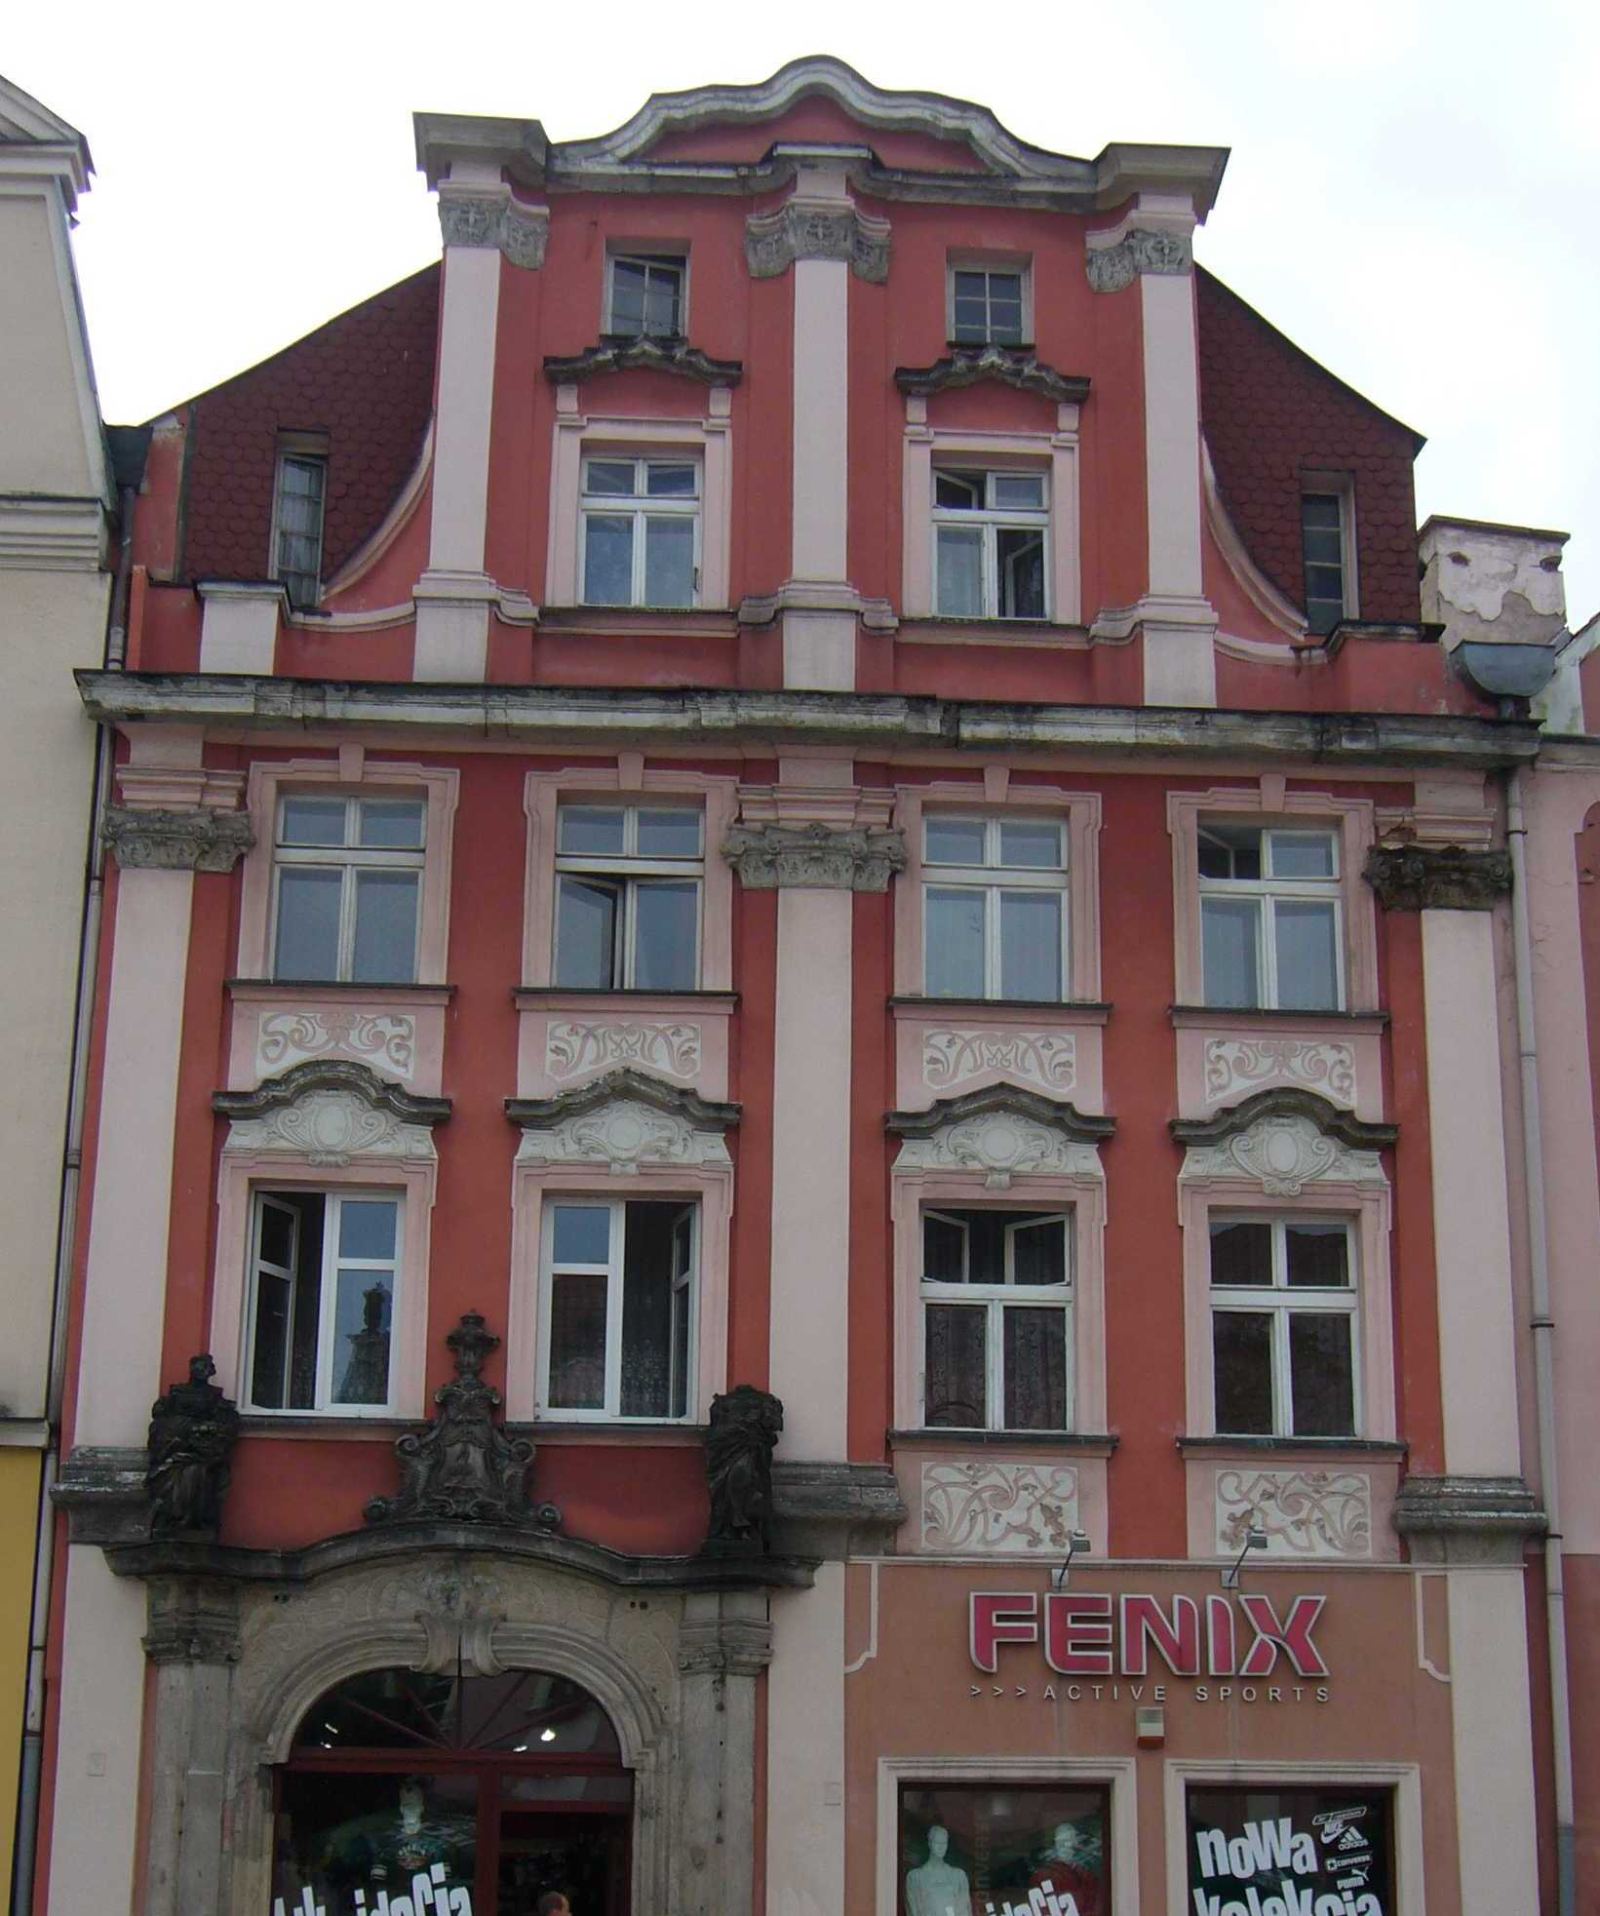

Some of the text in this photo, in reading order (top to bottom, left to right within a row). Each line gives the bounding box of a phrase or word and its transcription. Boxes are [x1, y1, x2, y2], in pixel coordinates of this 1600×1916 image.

[970, 1592, 1330, 1676] FENIX
[1044, 1685, 1329, 1701] ACTIVE SPORTS
